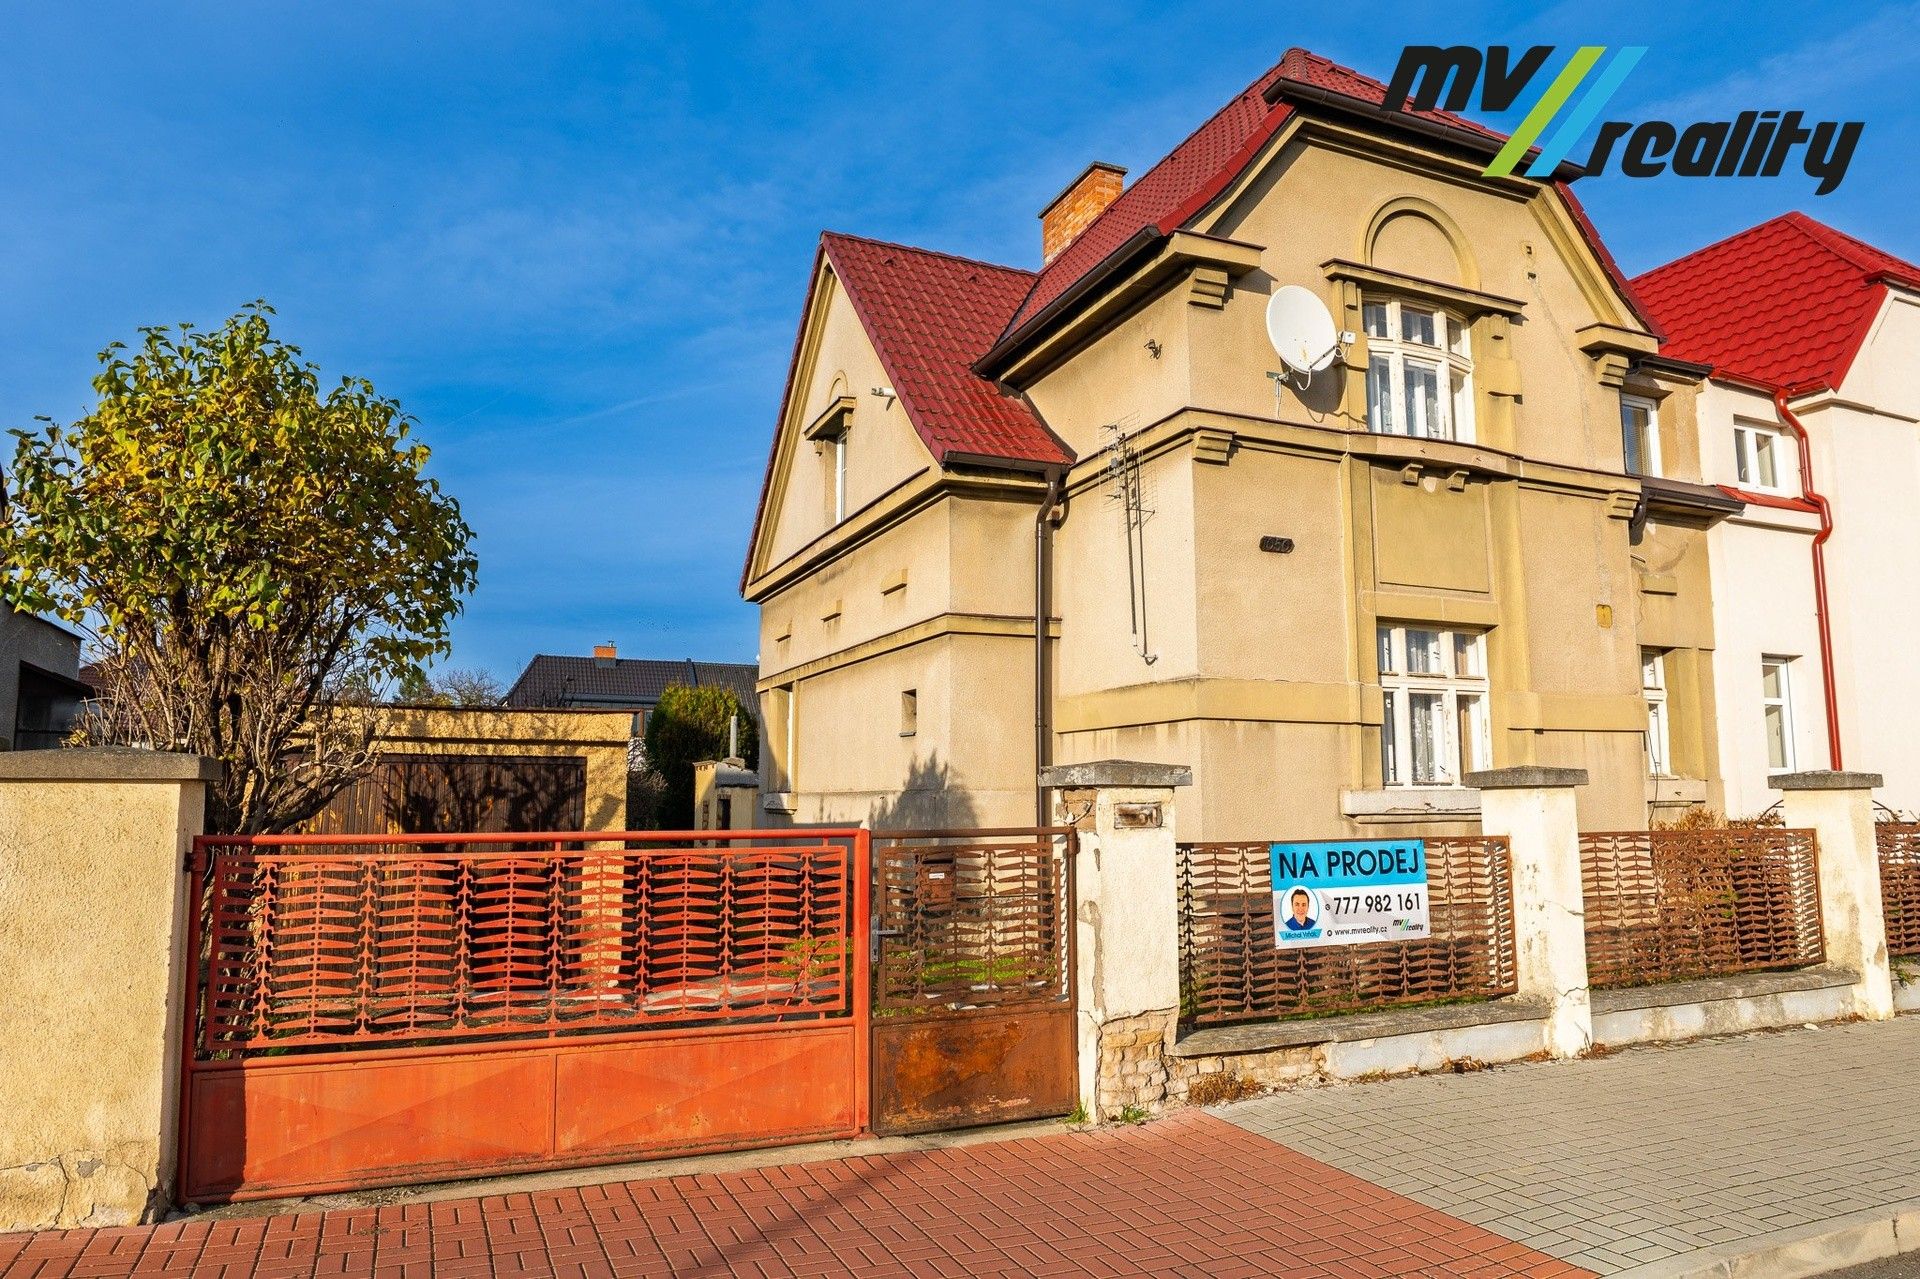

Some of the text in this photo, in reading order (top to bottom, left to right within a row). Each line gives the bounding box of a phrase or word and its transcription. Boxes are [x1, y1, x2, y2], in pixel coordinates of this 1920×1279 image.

[1279, 848, 1418, 878] NA PRODEJ
[1334, 893, 1420, 915] 777 982 161
[1335, 926, 1387, 936] www.mvreality.cz
